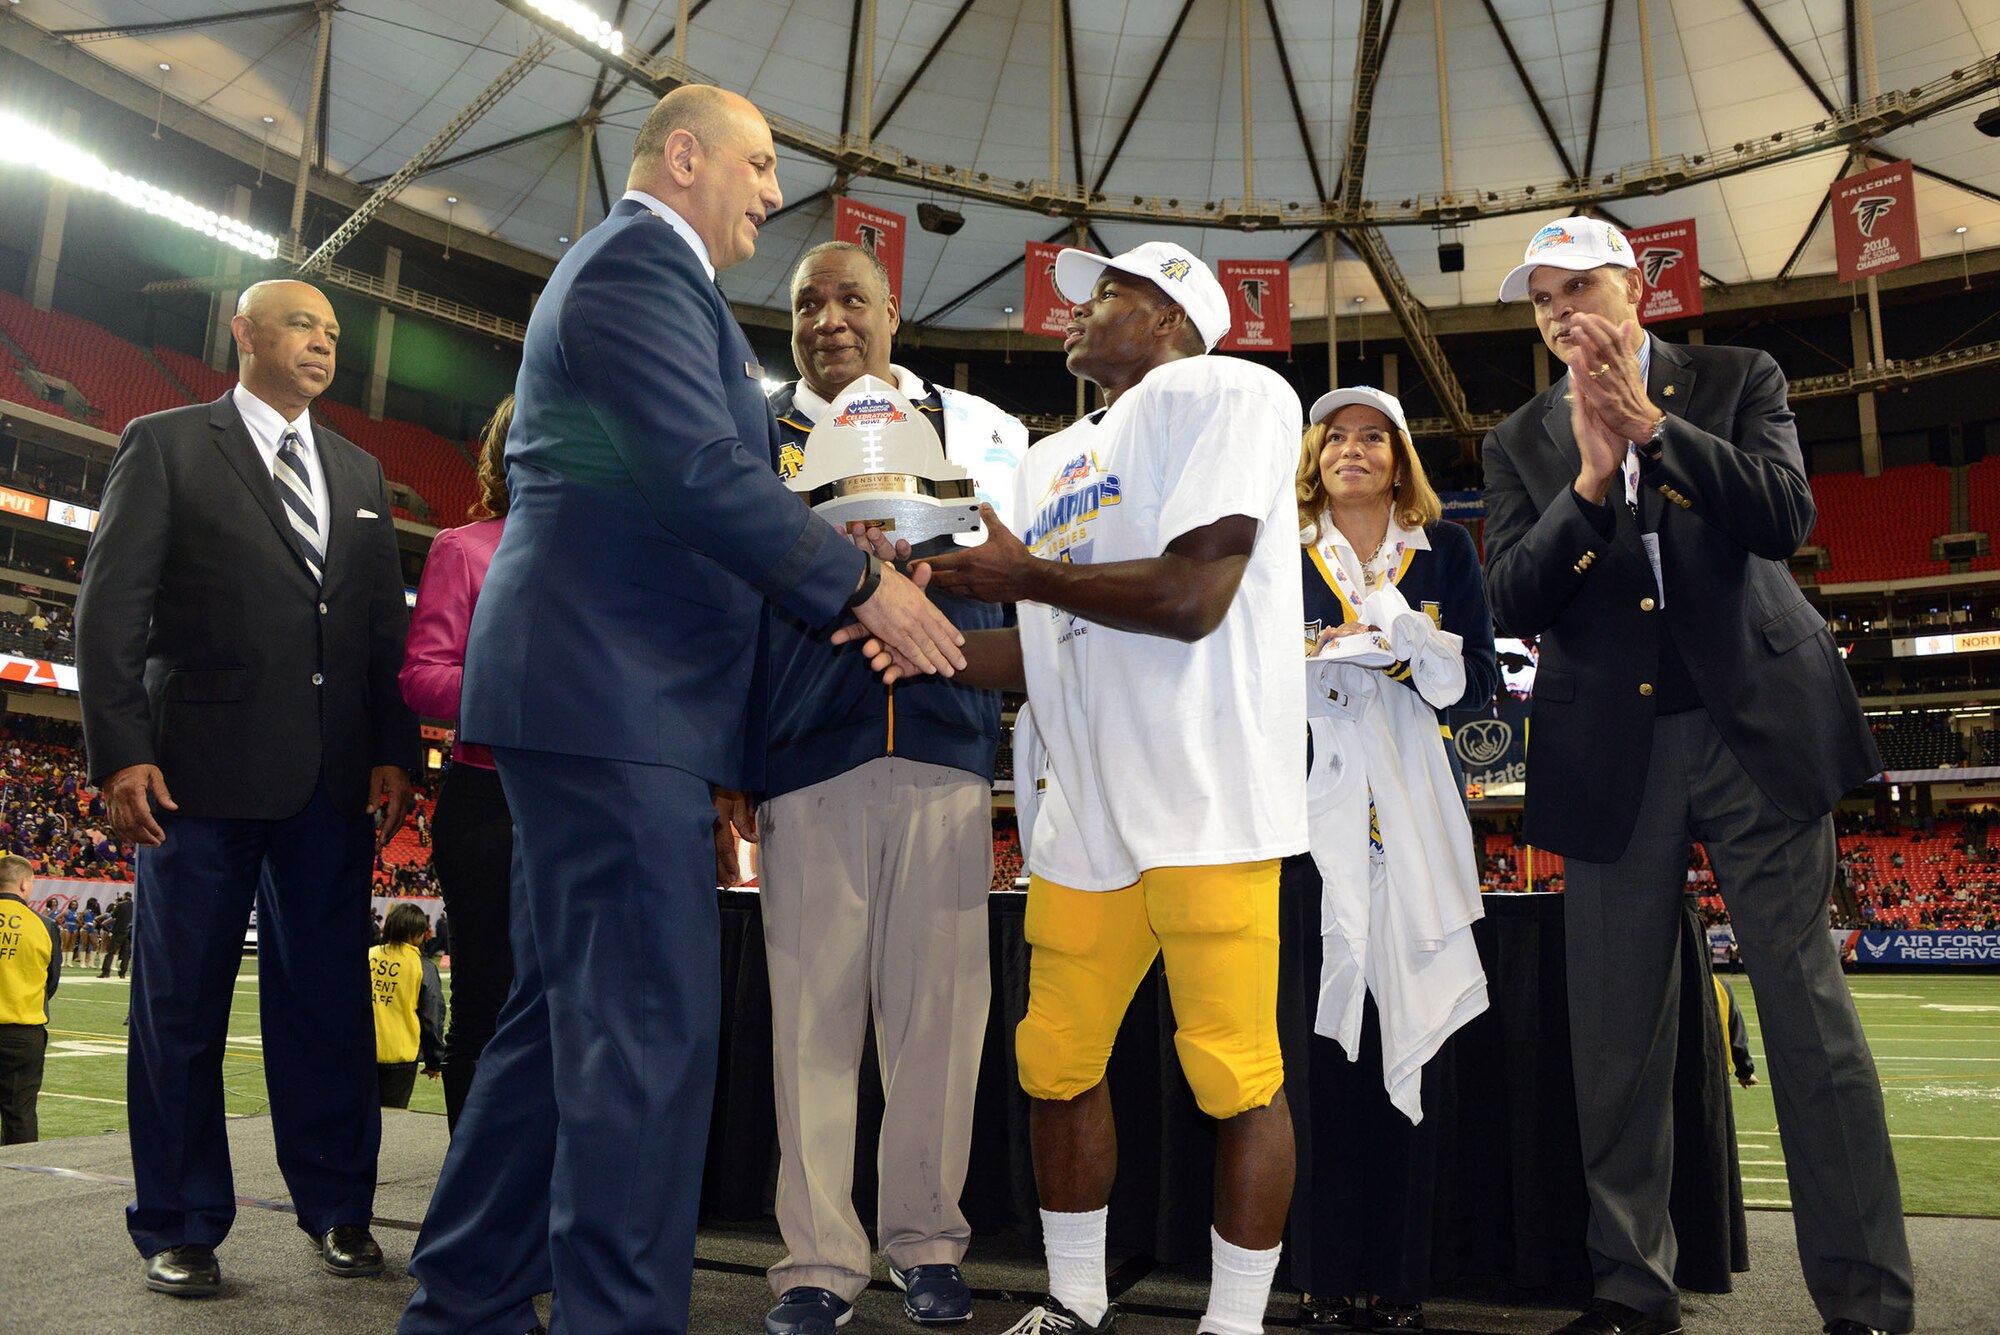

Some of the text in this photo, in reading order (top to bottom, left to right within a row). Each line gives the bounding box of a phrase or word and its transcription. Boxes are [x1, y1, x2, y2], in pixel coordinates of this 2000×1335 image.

[1841, 174, 1902, 198] FALCONS
[846, 207, 898, 228] FALCONS
[1630, 229, 1686, 244] FALCONS
[1863, 237, 1890, 254] 2010
[1872, 246, 1896, 259] SOUTH
[1856, 252, 1900, 271] CHAMPIONS
[1227, 267, 1281, 276] FALCONS
[1651, 289, 1673, 302] 2004
[1643, 304, 1683, 317] CHAMPIONS
[1236, 338, 1274, 346] CHAMPIONS
[845, 412, 895, 421] CELEBRATION
[847, 475, 890, 486] FENSIVE
[0, 492, 34, 513] POT
[1443, 499, 1485, 510] uthwest
[1894, 935, 2000, 947] AIR FORC
[1901, 947, 2000, 959] RESERVE
[371, 979, 398, 993] ENT
